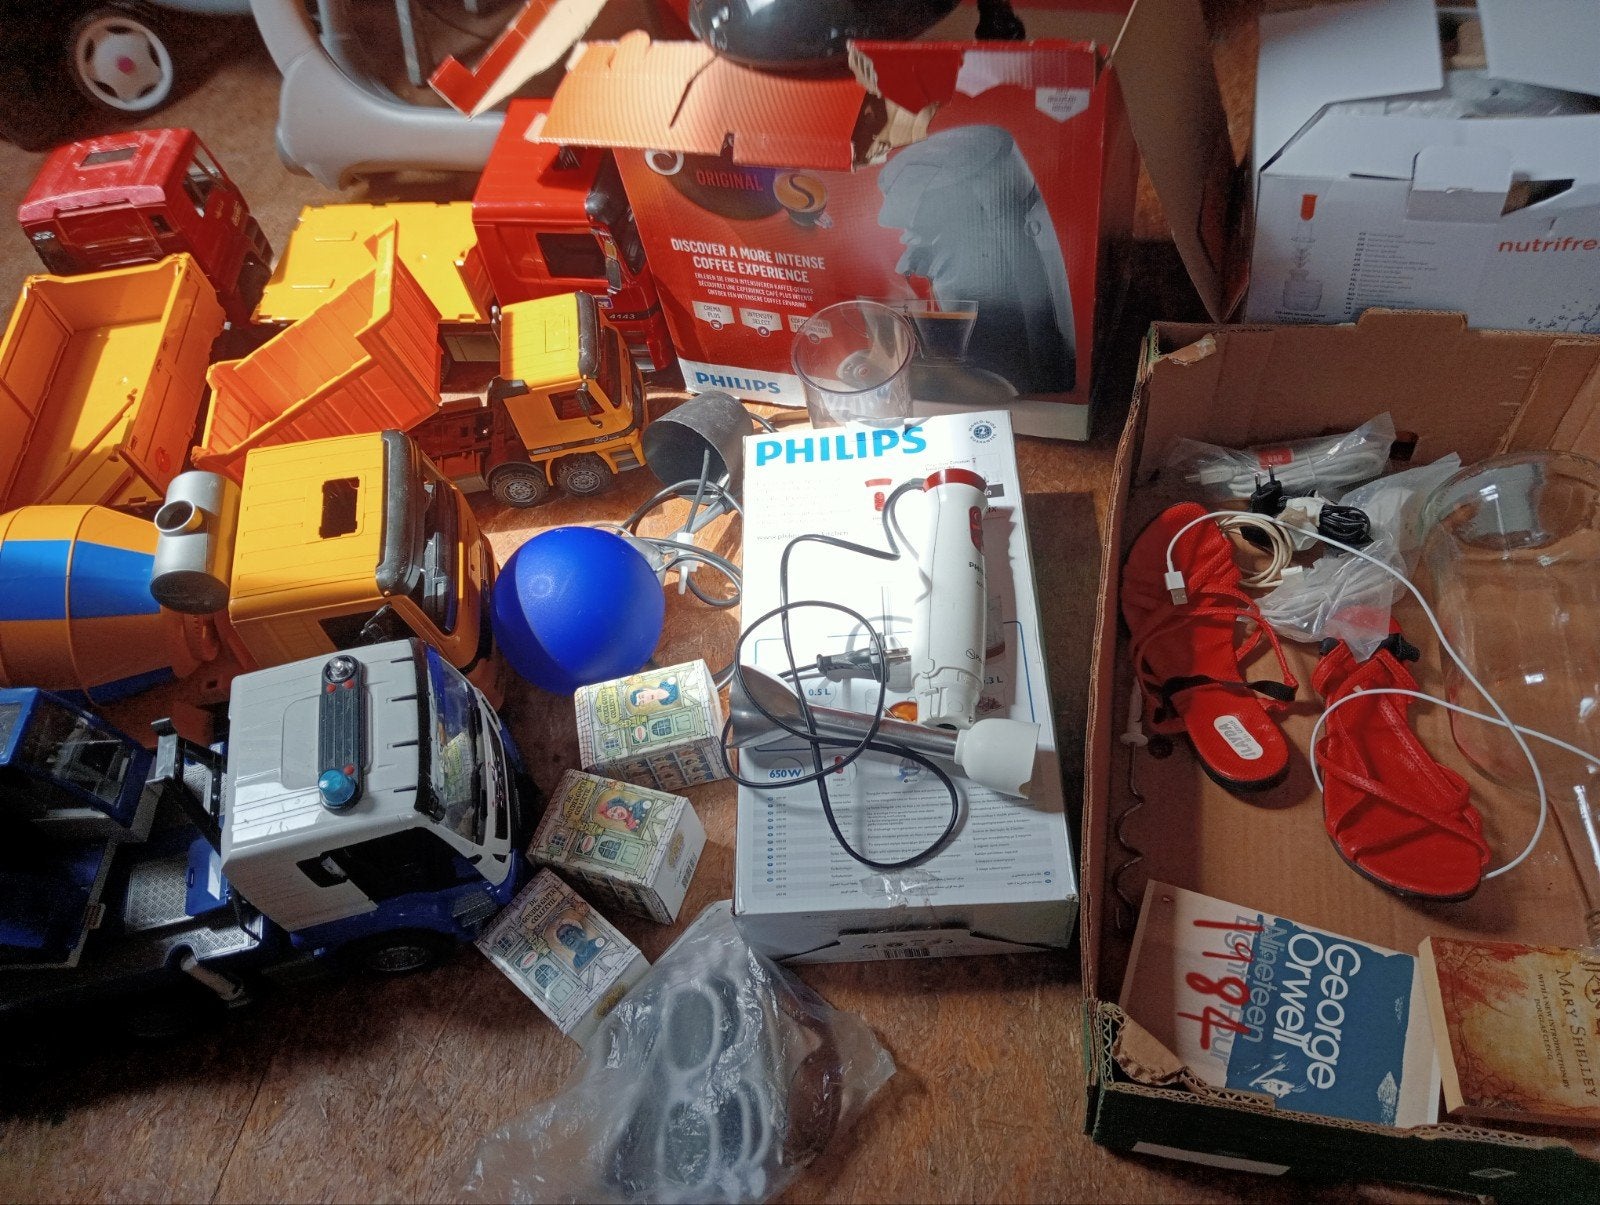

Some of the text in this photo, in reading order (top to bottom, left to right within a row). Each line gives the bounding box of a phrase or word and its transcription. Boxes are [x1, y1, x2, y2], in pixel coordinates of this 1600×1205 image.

[696, 170, 763, 191] ORIGINAL
[670, 238, 825, 270] DISCOVER A MORE INTENSE
[1498, 236, 1600, 253] nutrifre
[692, 256, 809, 283] COFFEE EXPERIENCE
[703, 304, 722, 313] CREMA
[707, 311, 721, 319] PLUS
[746, 311, 773, 320] INTENSITY
[752, 318, 771, 326] SELECT
[695, 371, 781, 394] PHILIPS
[756, 425, 927, 467] PHILIPS
[808, 687, 831, 697] 0.5 L
[1176, 918, 1264, 1051] 1984
[1242, 923, 1288, 1043] Nineteen
[1272, 933, 1324, 1048] Orwell
[1306, 943, 1362, 1090] George
[1534, 998, 1553, 1060] DOUGLAS CLEGG
[1544, 1001, 1553, 1019] NEW
[1549, 1019, 1567, 1080] INTRODUCTION
[1556, 969, 1578, 1018] MARY
[1570, 1026, 1598, 1097] SHELLEY
